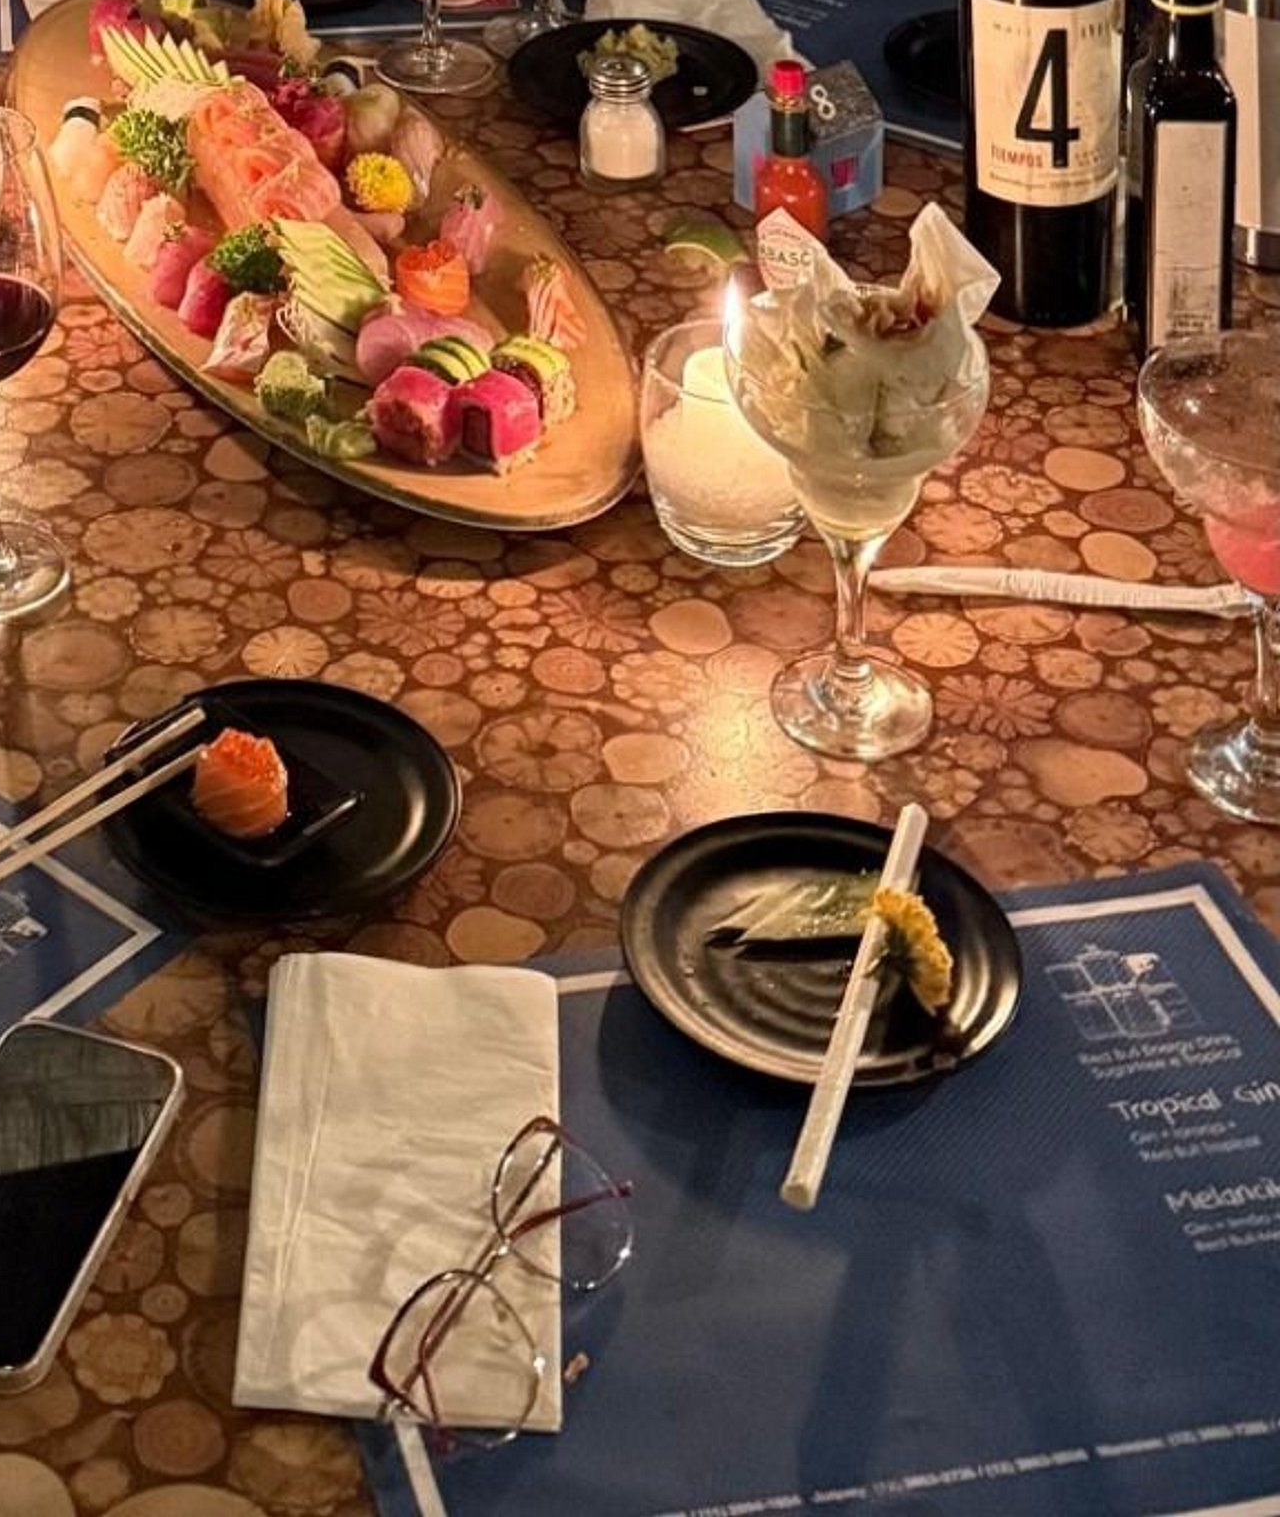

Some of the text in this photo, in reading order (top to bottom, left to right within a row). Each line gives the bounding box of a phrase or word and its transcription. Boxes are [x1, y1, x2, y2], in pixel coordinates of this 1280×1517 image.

[810, 84, 836, 120] 8
[1015, 28, 1081, 169] 4
[1107, 1087, 1223, 1126] Tropical
